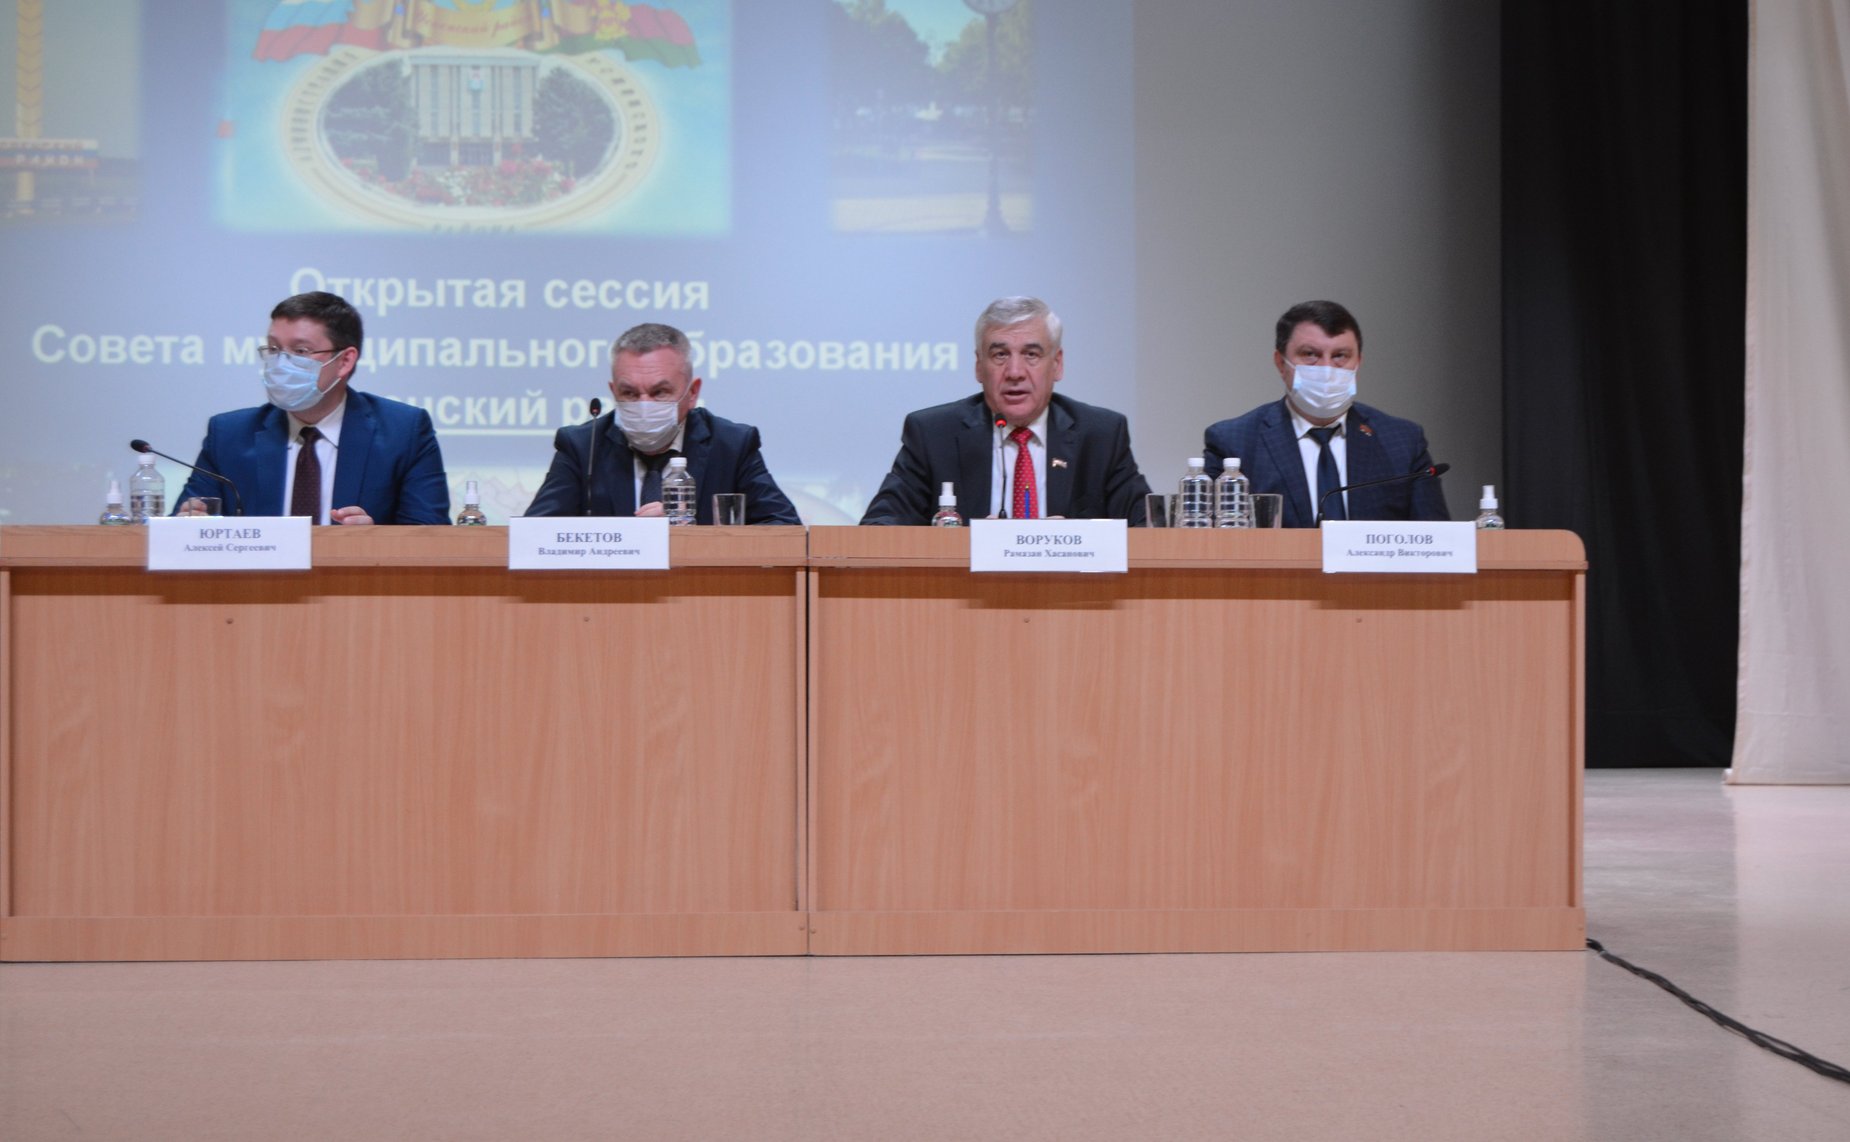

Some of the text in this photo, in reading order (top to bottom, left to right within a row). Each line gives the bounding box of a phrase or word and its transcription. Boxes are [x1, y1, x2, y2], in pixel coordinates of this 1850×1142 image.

[290, 267, 709, 316] Открытая сессия
[32, 324, 204, 365] Совета
[686, 331, 959, 379] бразования
[199, 528, 262, 540] ЮРТАЕВ
[556, 532, 623, 543] БЕКЕТОВ
[1016, 534, 1082, 545] ВОРУКОВ
[1365, 534, 1433, 545] ПОГОЛОВ
[184, 543, 277, 553] Алексей Сергеевич
[538, 547, 641, 557] Владимир Андреевич
[1004, 549, 1095, 558] Рамазан Хасанович
[1347, 549, 1453, 558] Александр Викторович
